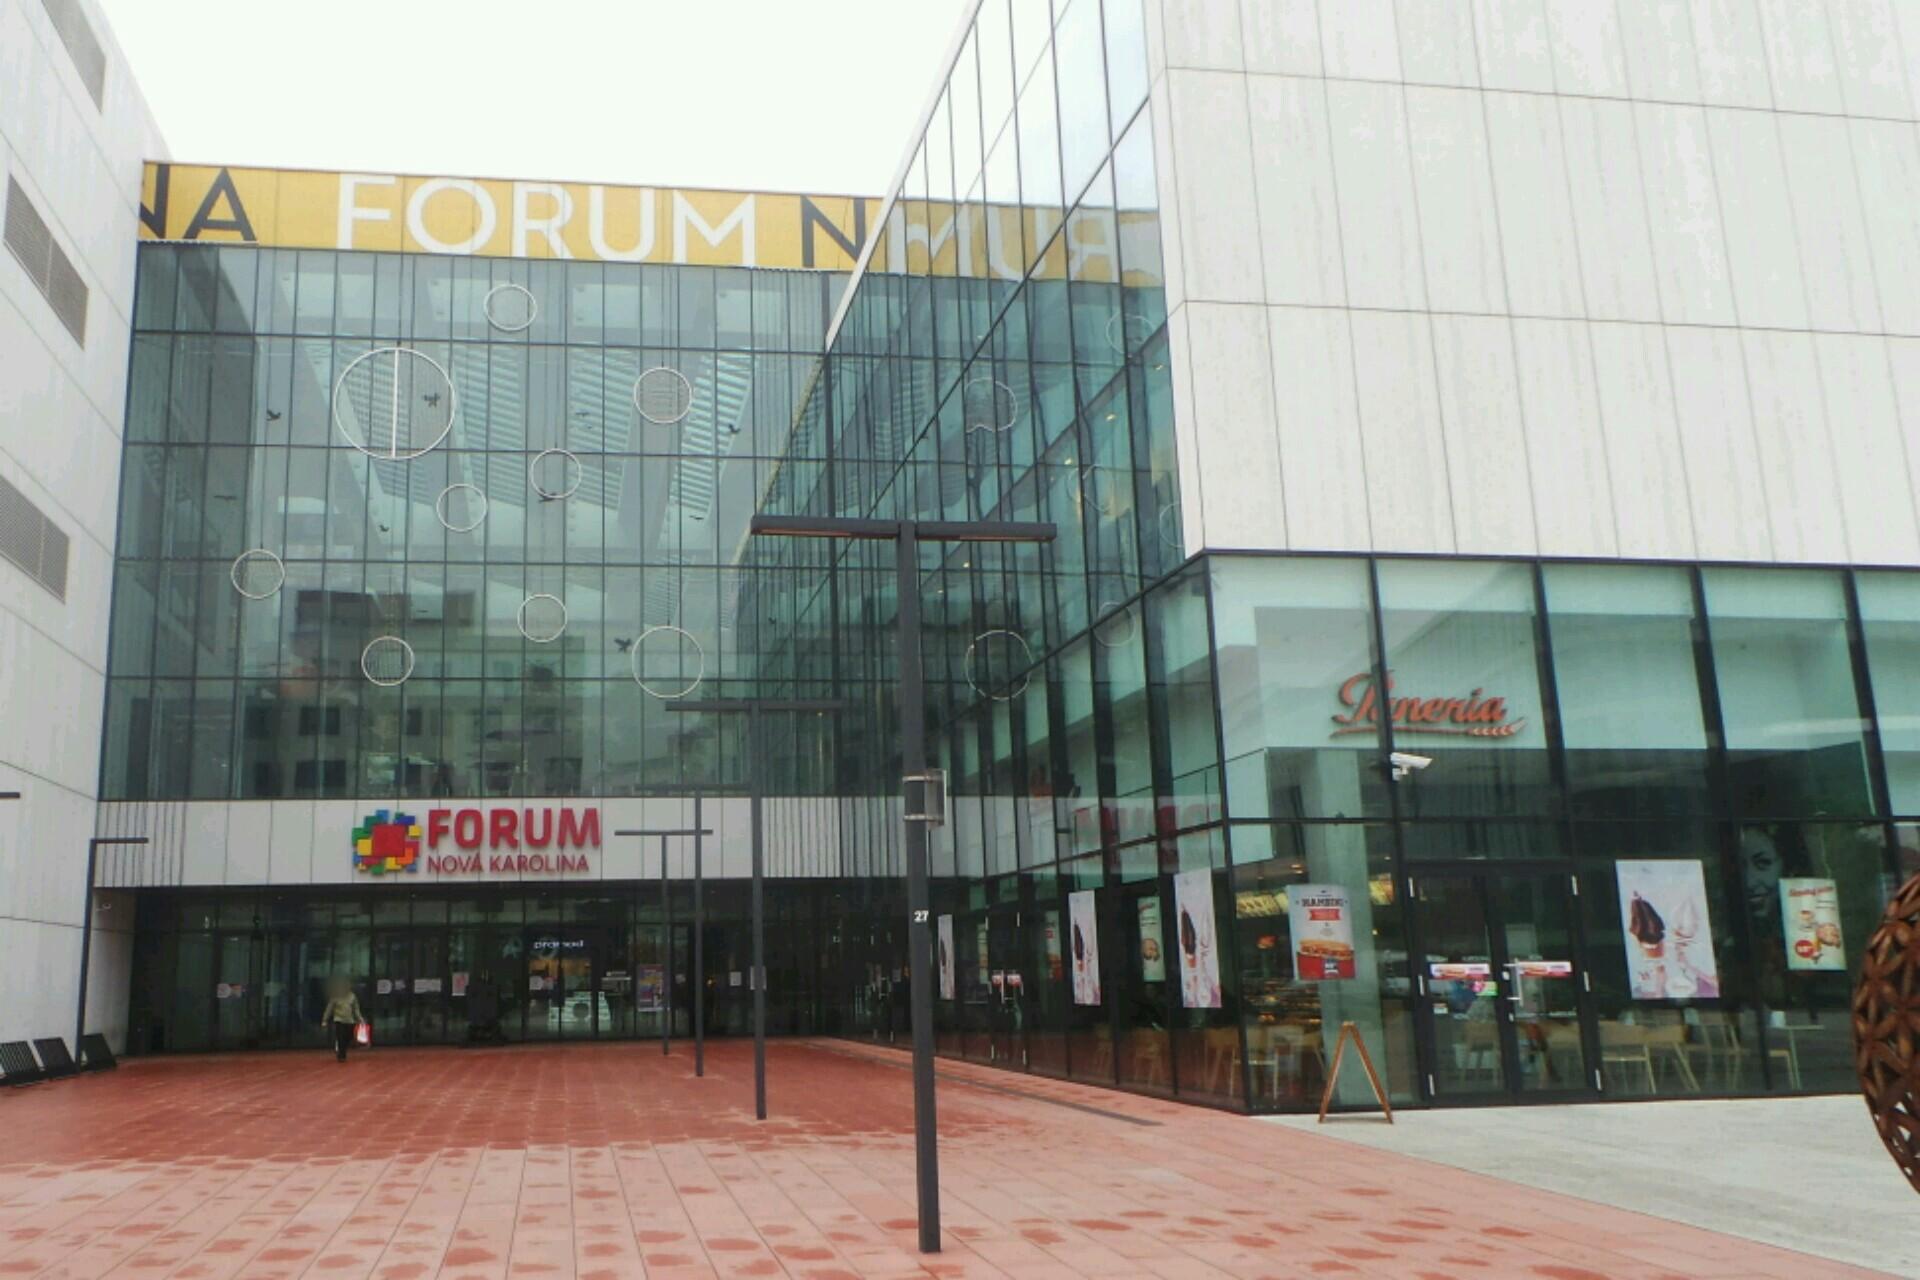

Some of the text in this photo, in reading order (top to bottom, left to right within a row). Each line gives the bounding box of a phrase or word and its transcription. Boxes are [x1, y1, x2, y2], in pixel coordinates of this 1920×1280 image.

[336, 174, 756, 267] FORUM
[427, 807, 600, 849] FORUM
[427, 852, 590, 874] NOVÁ KAROLINA
[913, 909, 929, 923] 27
